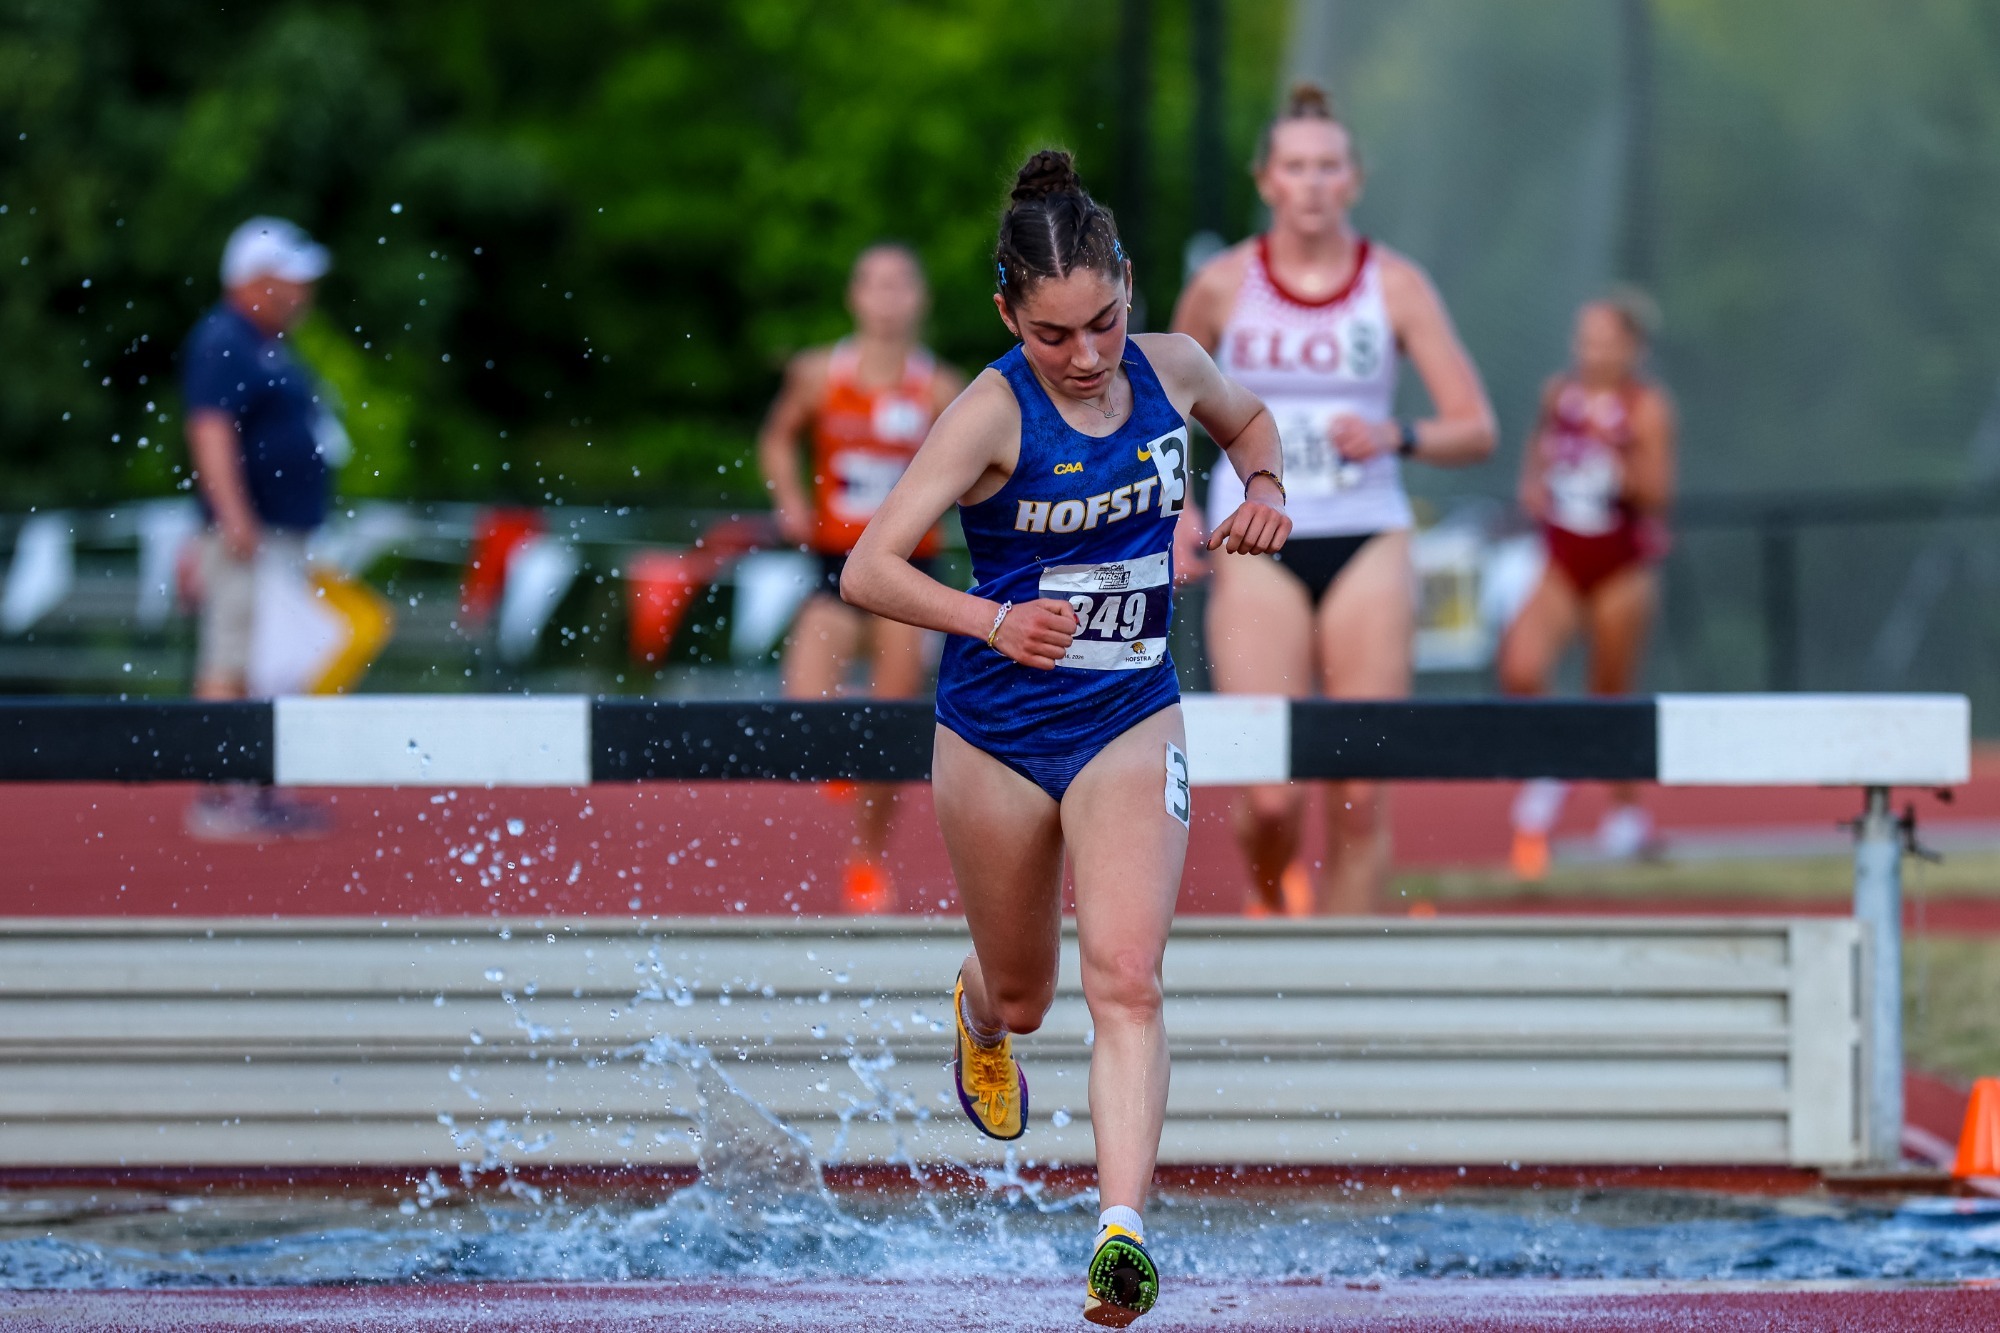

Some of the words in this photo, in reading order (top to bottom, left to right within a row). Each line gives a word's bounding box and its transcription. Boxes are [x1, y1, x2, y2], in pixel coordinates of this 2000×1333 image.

[1053, 461, 1084, 475] CAA
[1159, 436, 1187, 512] 3
[1014, 475, 1165, 534] HOFST
[1094, 570, 1123, 580] TRACK
[1099, 580, 1129, 589] FIELD
[1069, 592, 1147, 639] 349
[1125, 655, 1152, 663] HOFSTRA
[1173, 752, 1188, 822] 3
